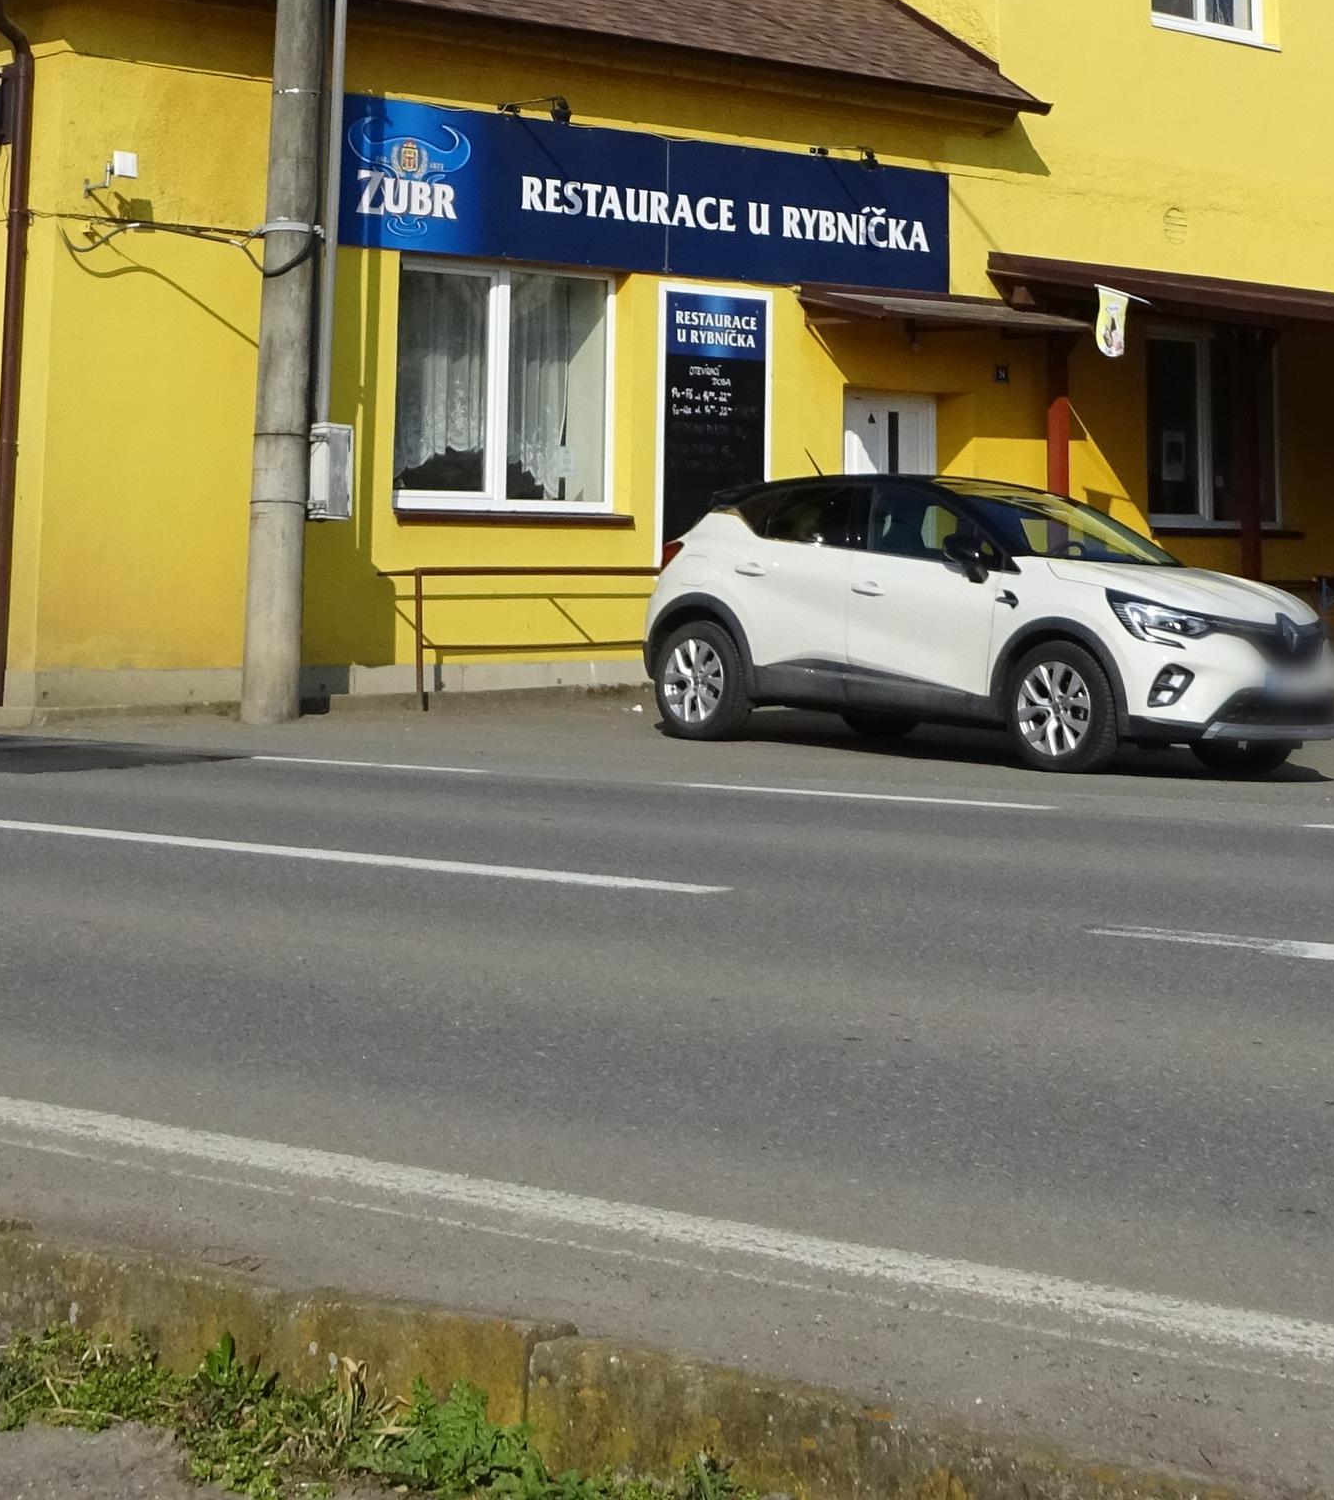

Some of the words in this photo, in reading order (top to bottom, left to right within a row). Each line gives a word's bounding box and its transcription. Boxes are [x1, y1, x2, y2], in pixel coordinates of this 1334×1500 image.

[356, 168, 457, 220] ZUBR
[521, 175, 736, 233] RESTAURACE
[748, 204, 769, 236] U
[782, 206, 930, 253] RYBNÍČKA
[675, 310, 757, 331] RESTAURACE
[677, 328, 686, 343] U
[690, 329, 756, 348] RYBNÍČKA
